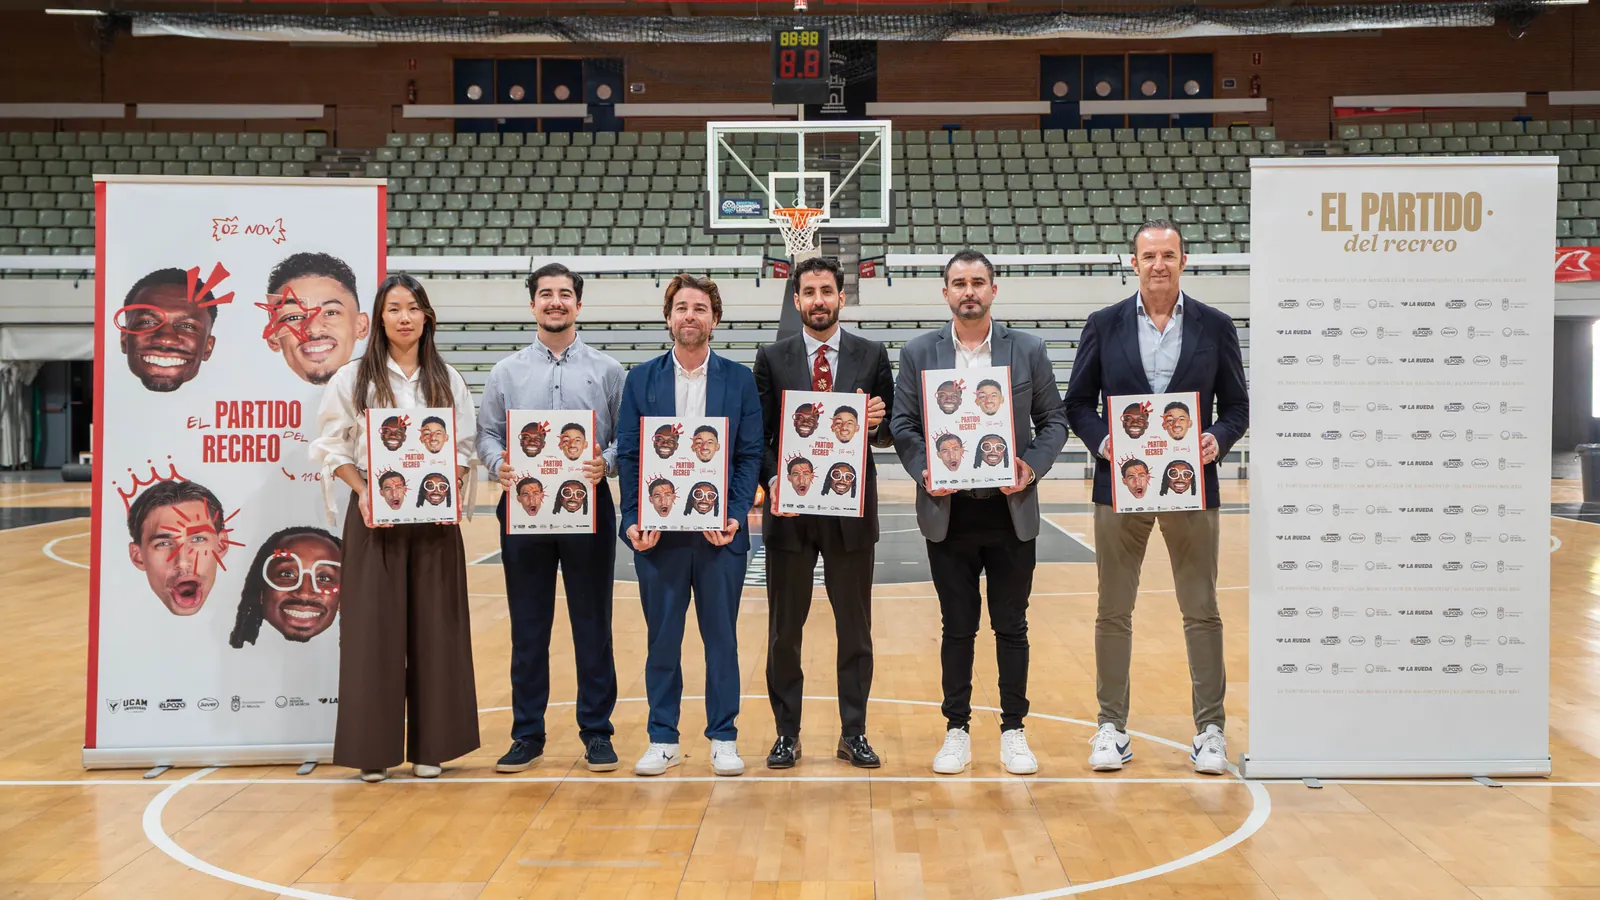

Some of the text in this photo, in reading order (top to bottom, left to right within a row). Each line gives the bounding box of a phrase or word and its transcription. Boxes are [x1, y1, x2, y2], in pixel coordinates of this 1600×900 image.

[780, 31, 818, 46] 88:88
[781, 50, 819, 77] 8.8
[1321, 192, 1483, 232] EL PARTIDO
[221, 224, 275, 235] 02 NOV
[1344, 234, 1458, 252] del recreo
[186, 400, 301, 429] EL PARTIDO
[283, 431, 308, 442] DEL
[203, 434, 280, 463] RECREO
[123, 698, 147, 707] UCAM
